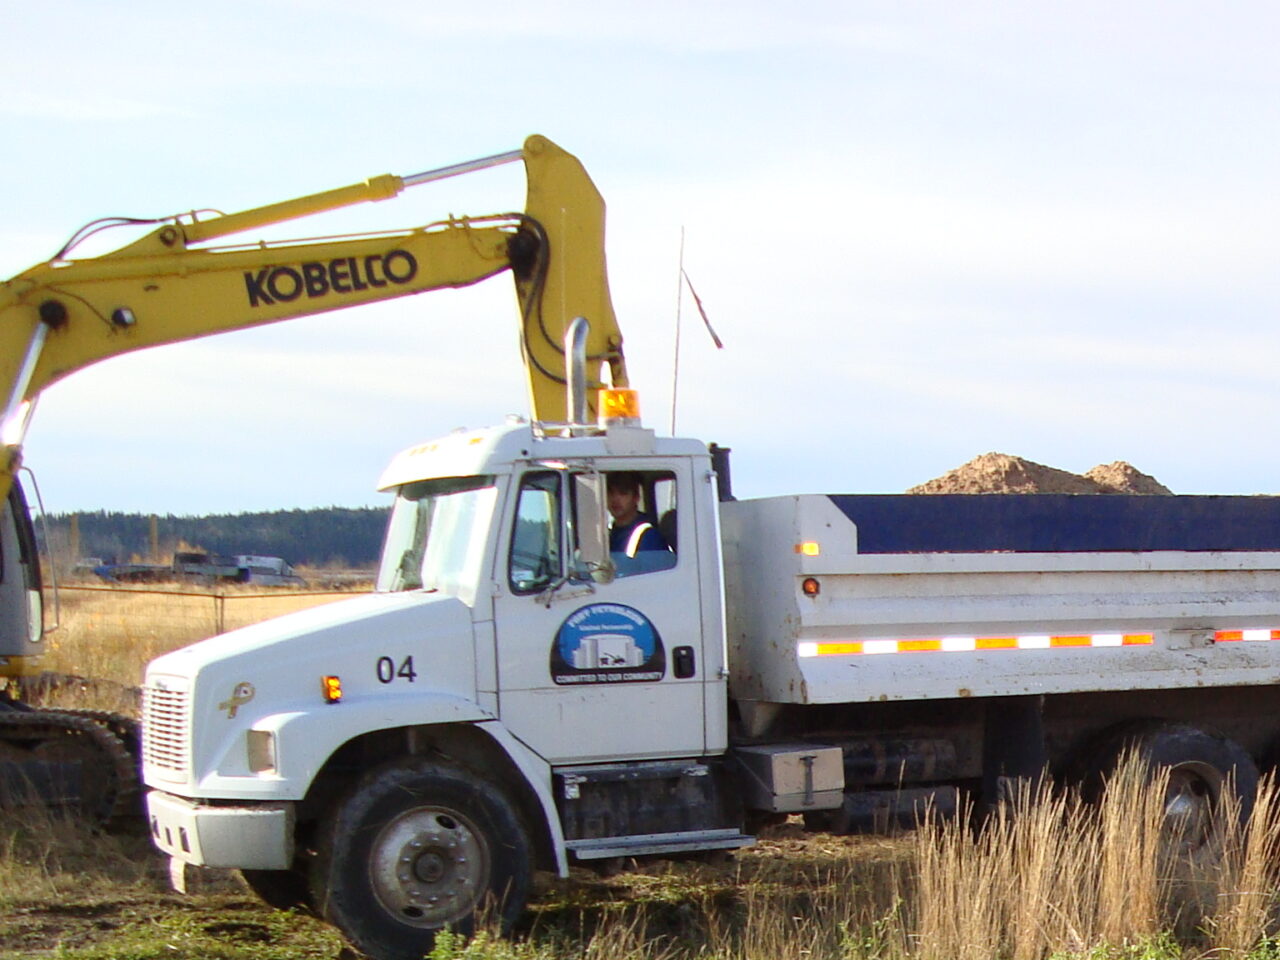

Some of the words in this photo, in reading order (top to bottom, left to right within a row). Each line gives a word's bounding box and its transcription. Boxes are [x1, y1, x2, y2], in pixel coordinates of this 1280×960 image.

[244, 249, 418, 307] KOBELCO
[376, 655, 417, 684] 04
[556, 674, 597, 683] COMMITTED
[607, 672, 622, 682] OUR
[623, 671, 663, 681] COMMUNITY
